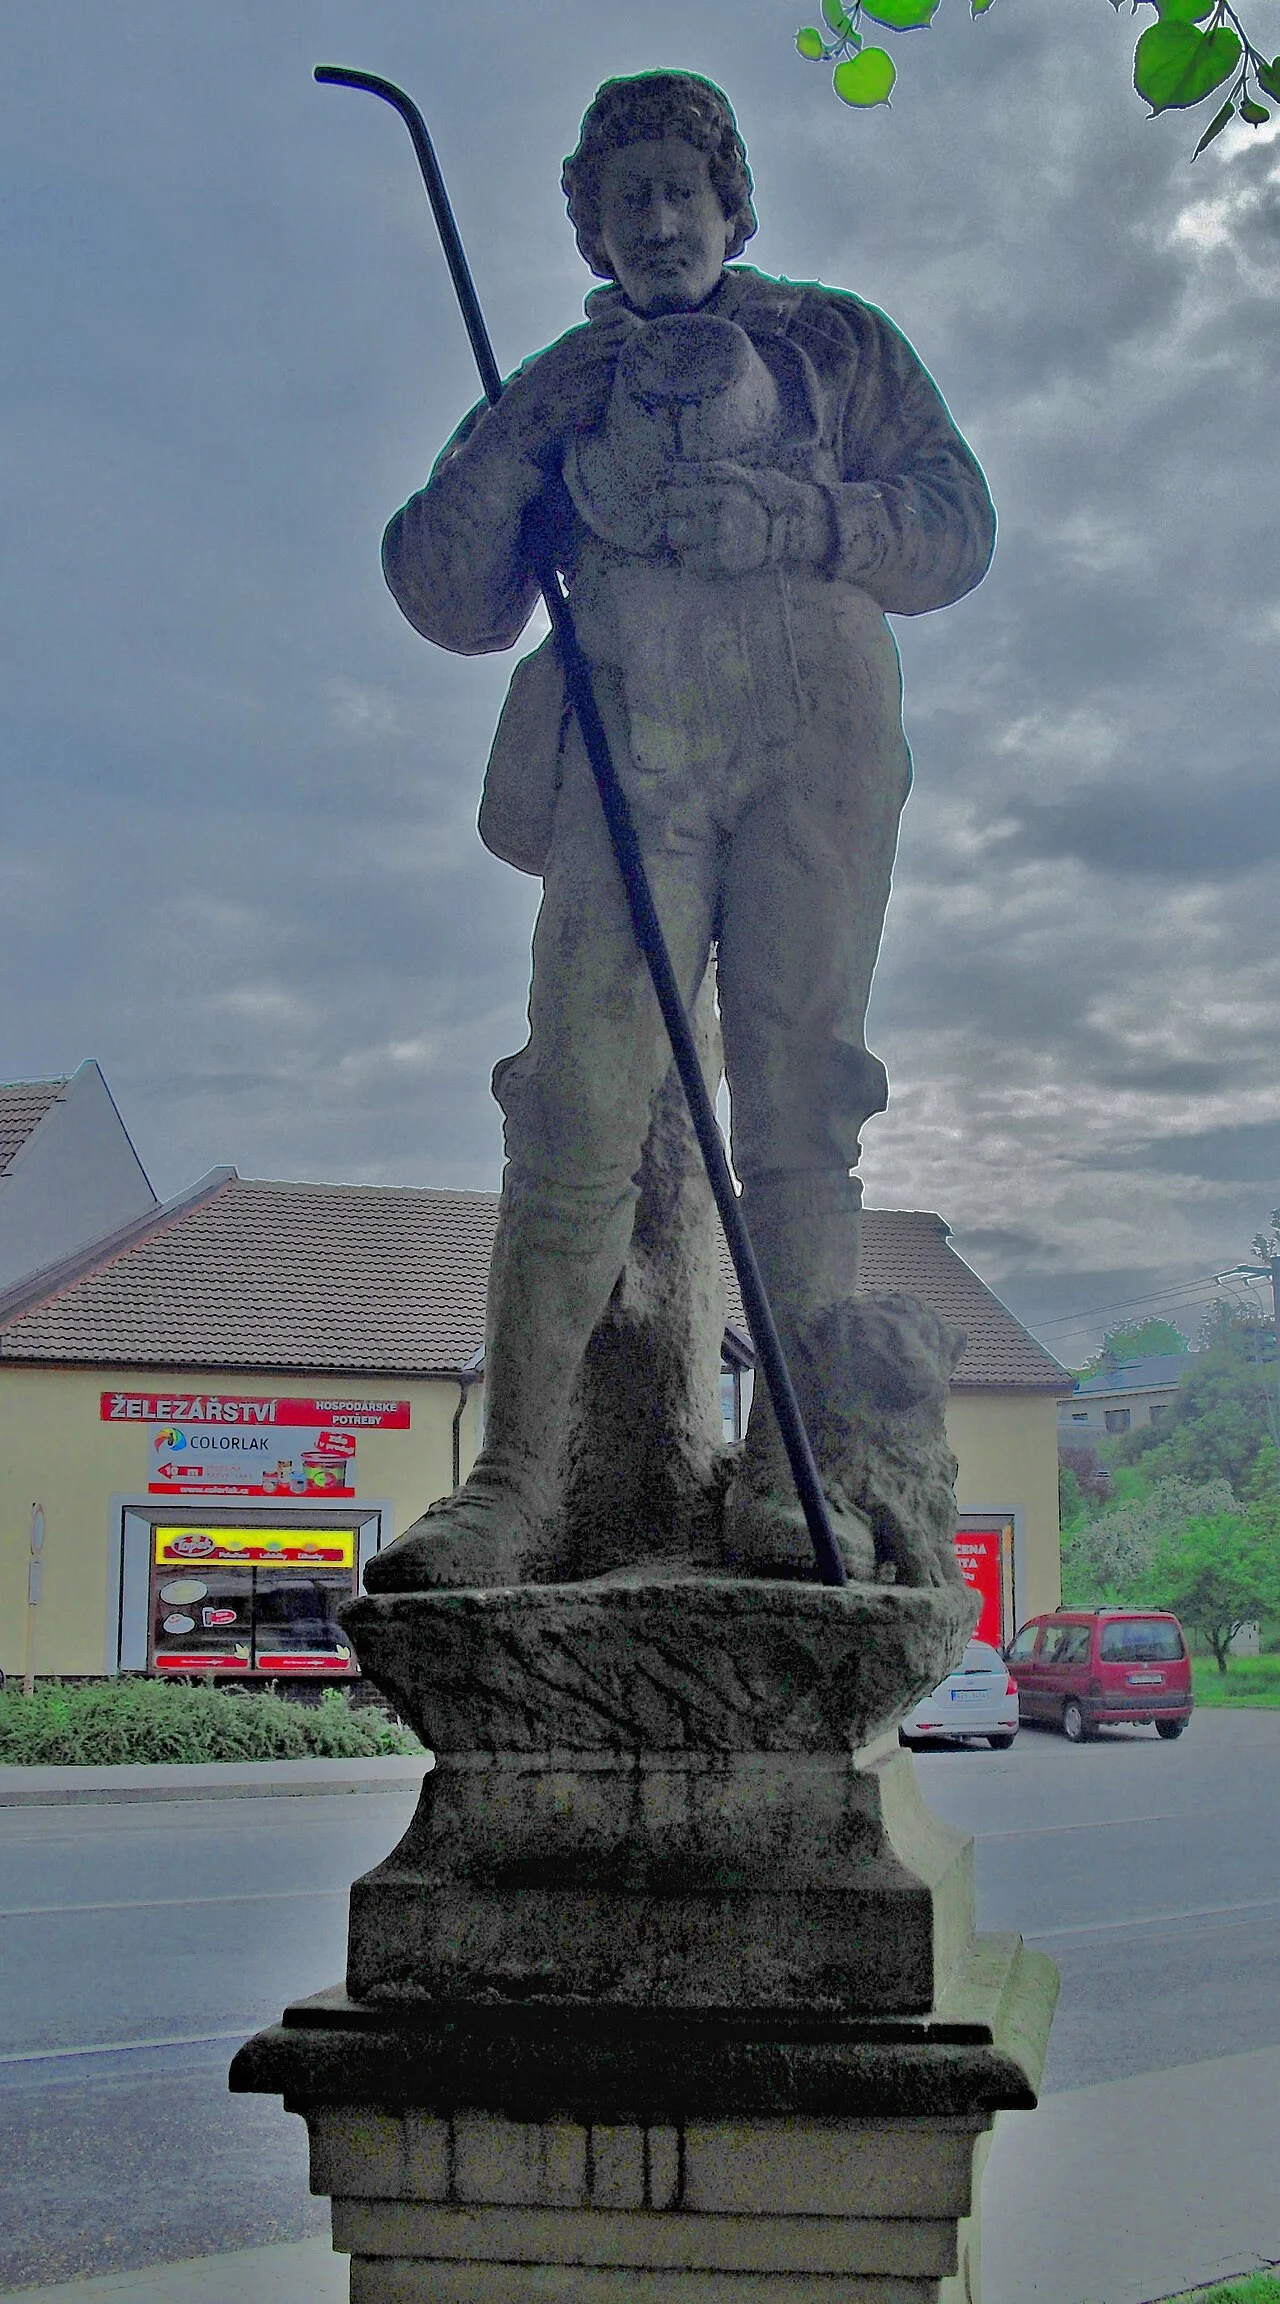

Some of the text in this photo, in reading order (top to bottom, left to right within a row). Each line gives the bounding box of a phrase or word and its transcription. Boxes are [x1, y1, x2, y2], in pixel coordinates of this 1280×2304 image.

[110, 1394, 277, 1422] ŽELEZÁŘSTVÍ
[315, 1400, 397, 1412] HOSPODÁŘSKÉ
[332, 1413, 382, 1425] POTŘEBY
[190, 1436, 269, 1450] COLORLAK
